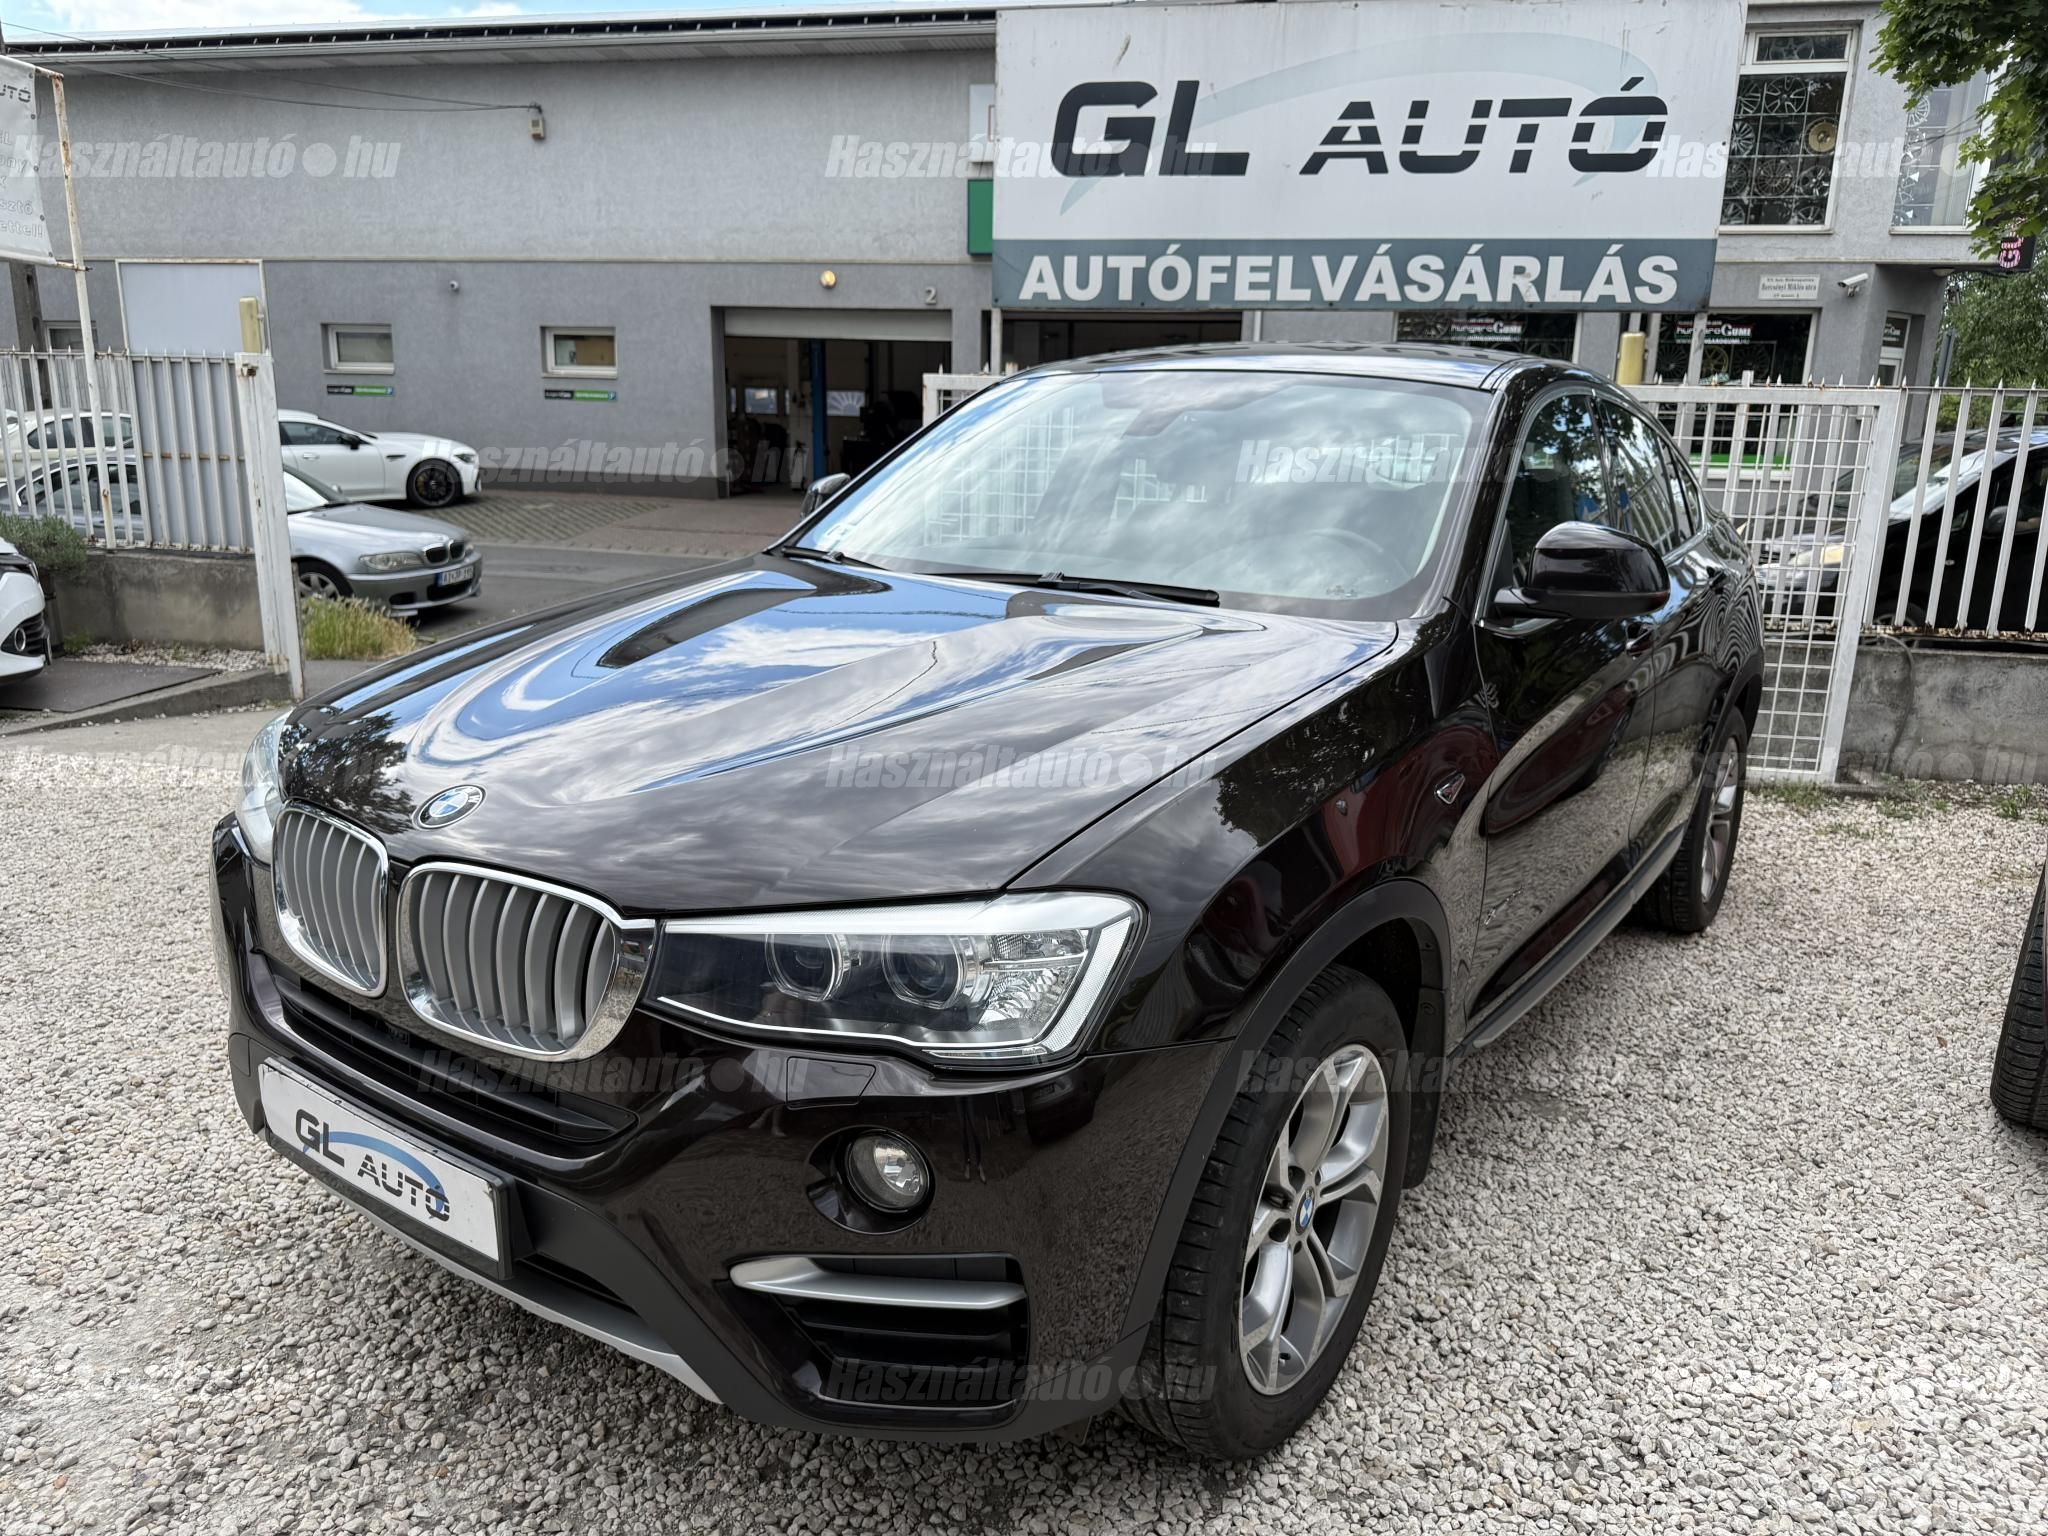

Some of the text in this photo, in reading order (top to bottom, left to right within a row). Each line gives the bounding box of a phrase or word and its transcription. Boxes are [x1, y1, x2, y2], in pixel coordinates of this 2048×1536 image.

[1050, 76, 1669, 177] GL AUTÓ
[925, 286, 937, 304] 2
[1018, 243, 1679, 304] AUTÓFELVÁSÁRLÁS
[296, 1108, 345, 1168] GL
